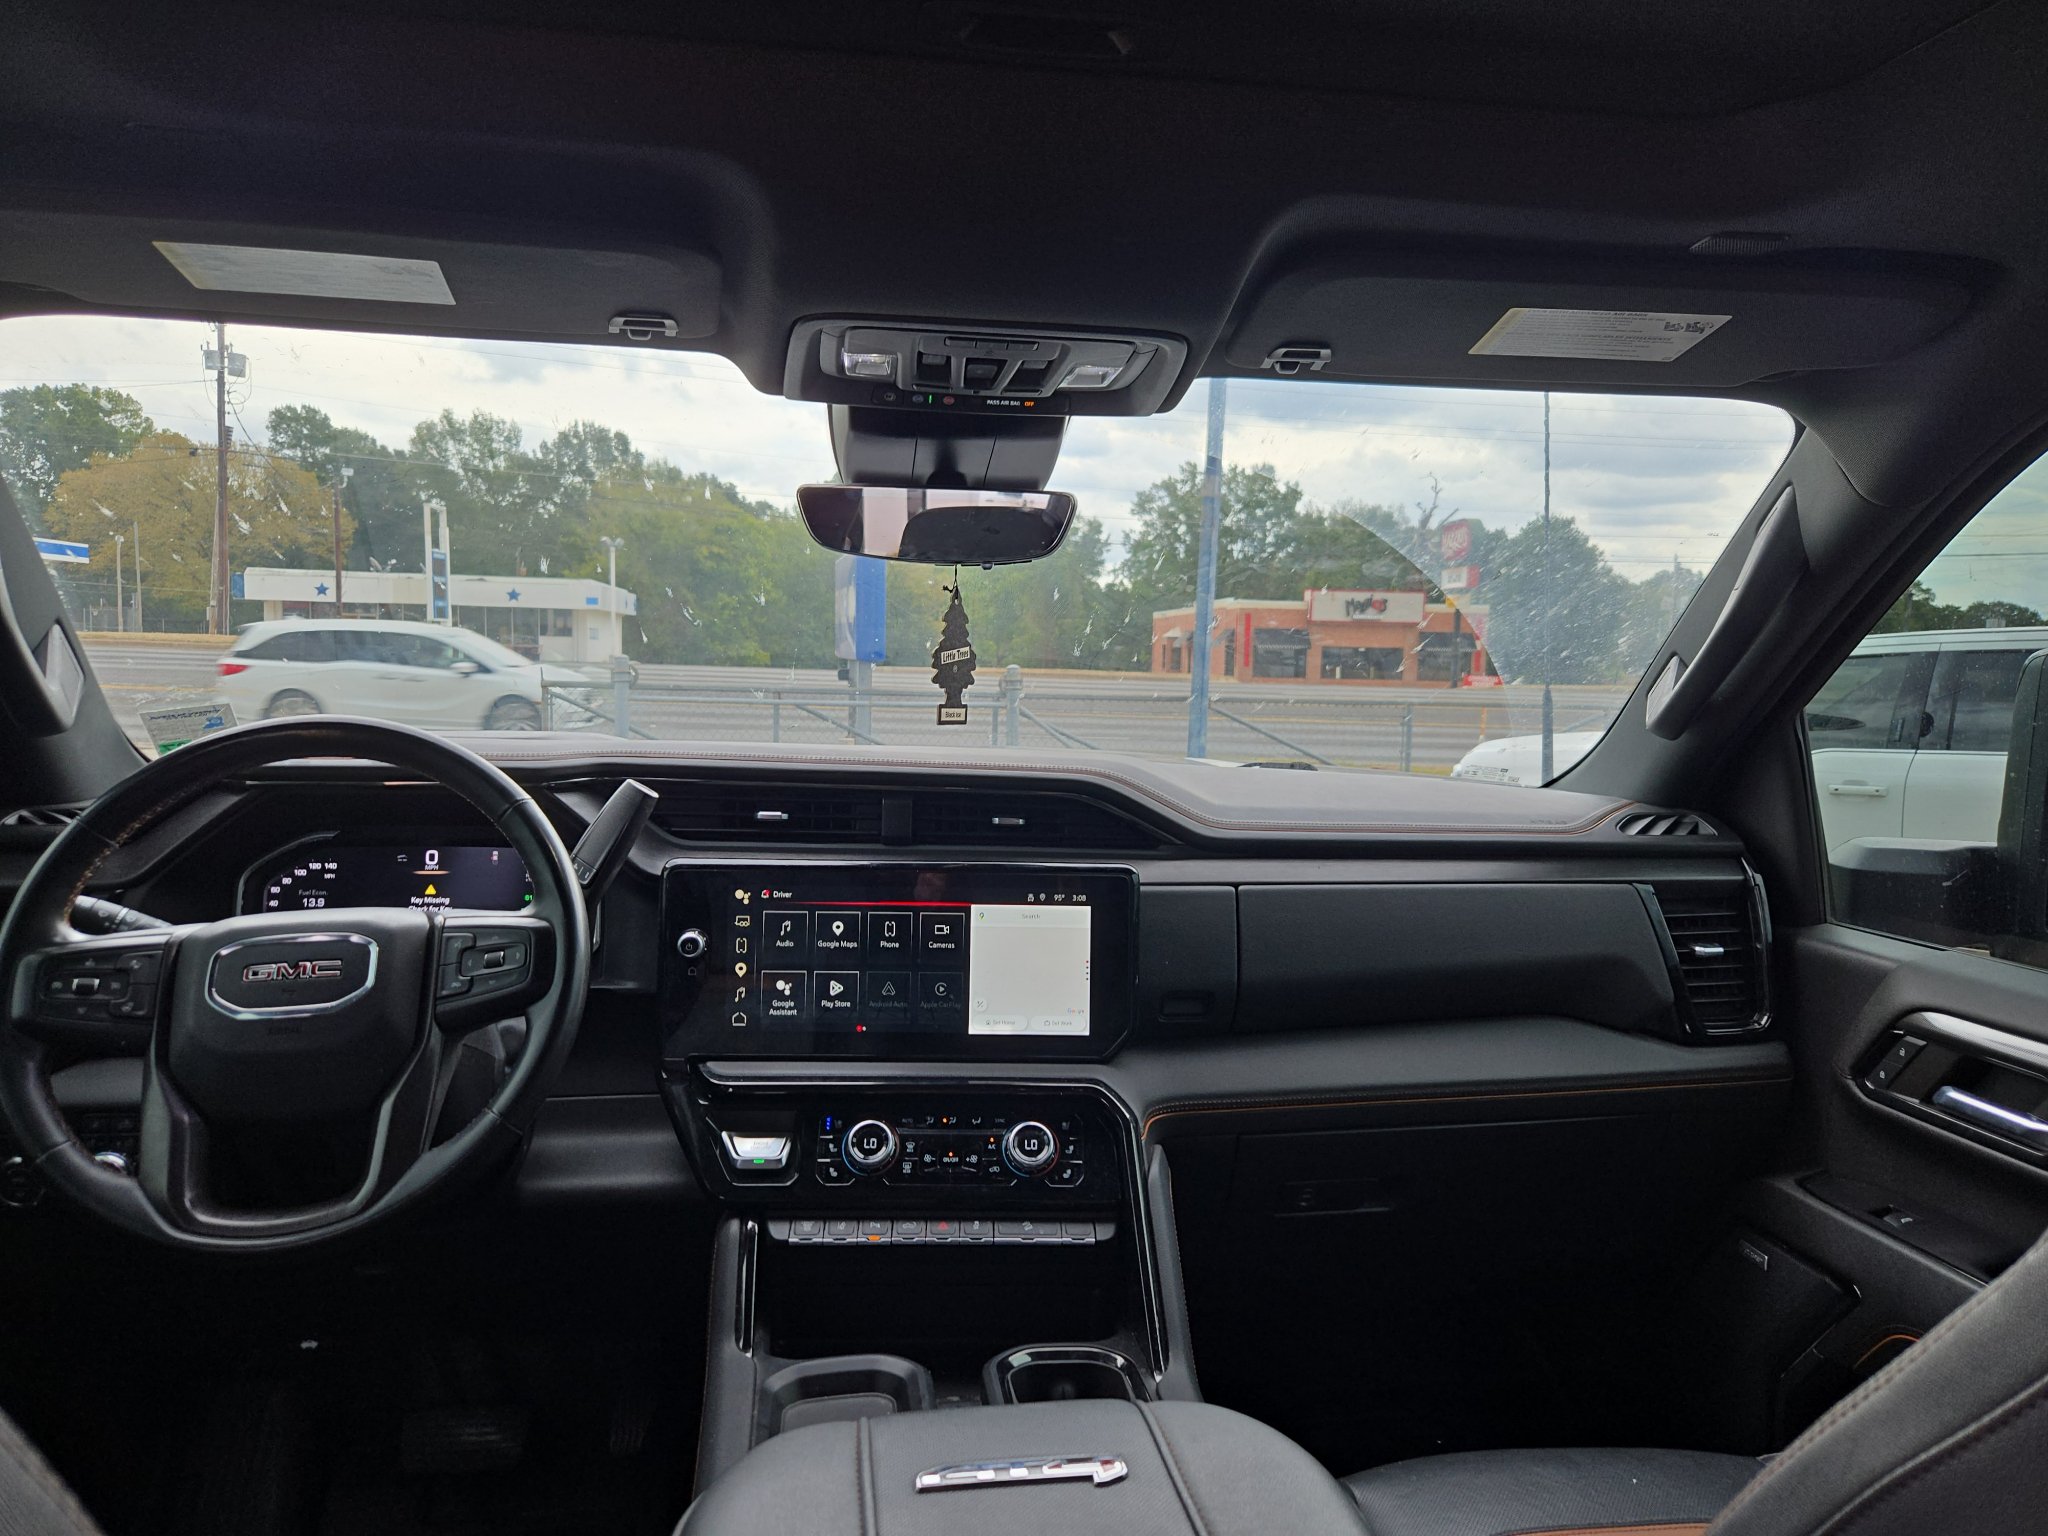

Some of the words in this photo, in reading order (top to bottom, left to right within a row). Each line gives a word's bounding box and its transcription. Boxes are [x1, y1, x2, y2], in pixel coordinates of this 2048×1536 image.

[942, 650, 956, 663] Little
[956, 649, 970, 660] Trees
[425, 849, 439, 865] 0
[324, 862, 338, 870] 140
[773, 890, 792, 898] Driver
[268, 899, 279, 907] 40
[302, 898, 325, 907] 13.9
[410, 896, 424, 905] Key
[424, 896, 450, 905] Missing
[817, 940, 840, 949] Google
[840, 940, 858, 948] Maps
[928, 941, 955, 949] Cameras
[242, 959, 342, 983] GMC
[772, 1000, 795, 1008] Google
[821, 1000, 834, 1008] Play
[769, 1008, 798, 1016] Assistant
